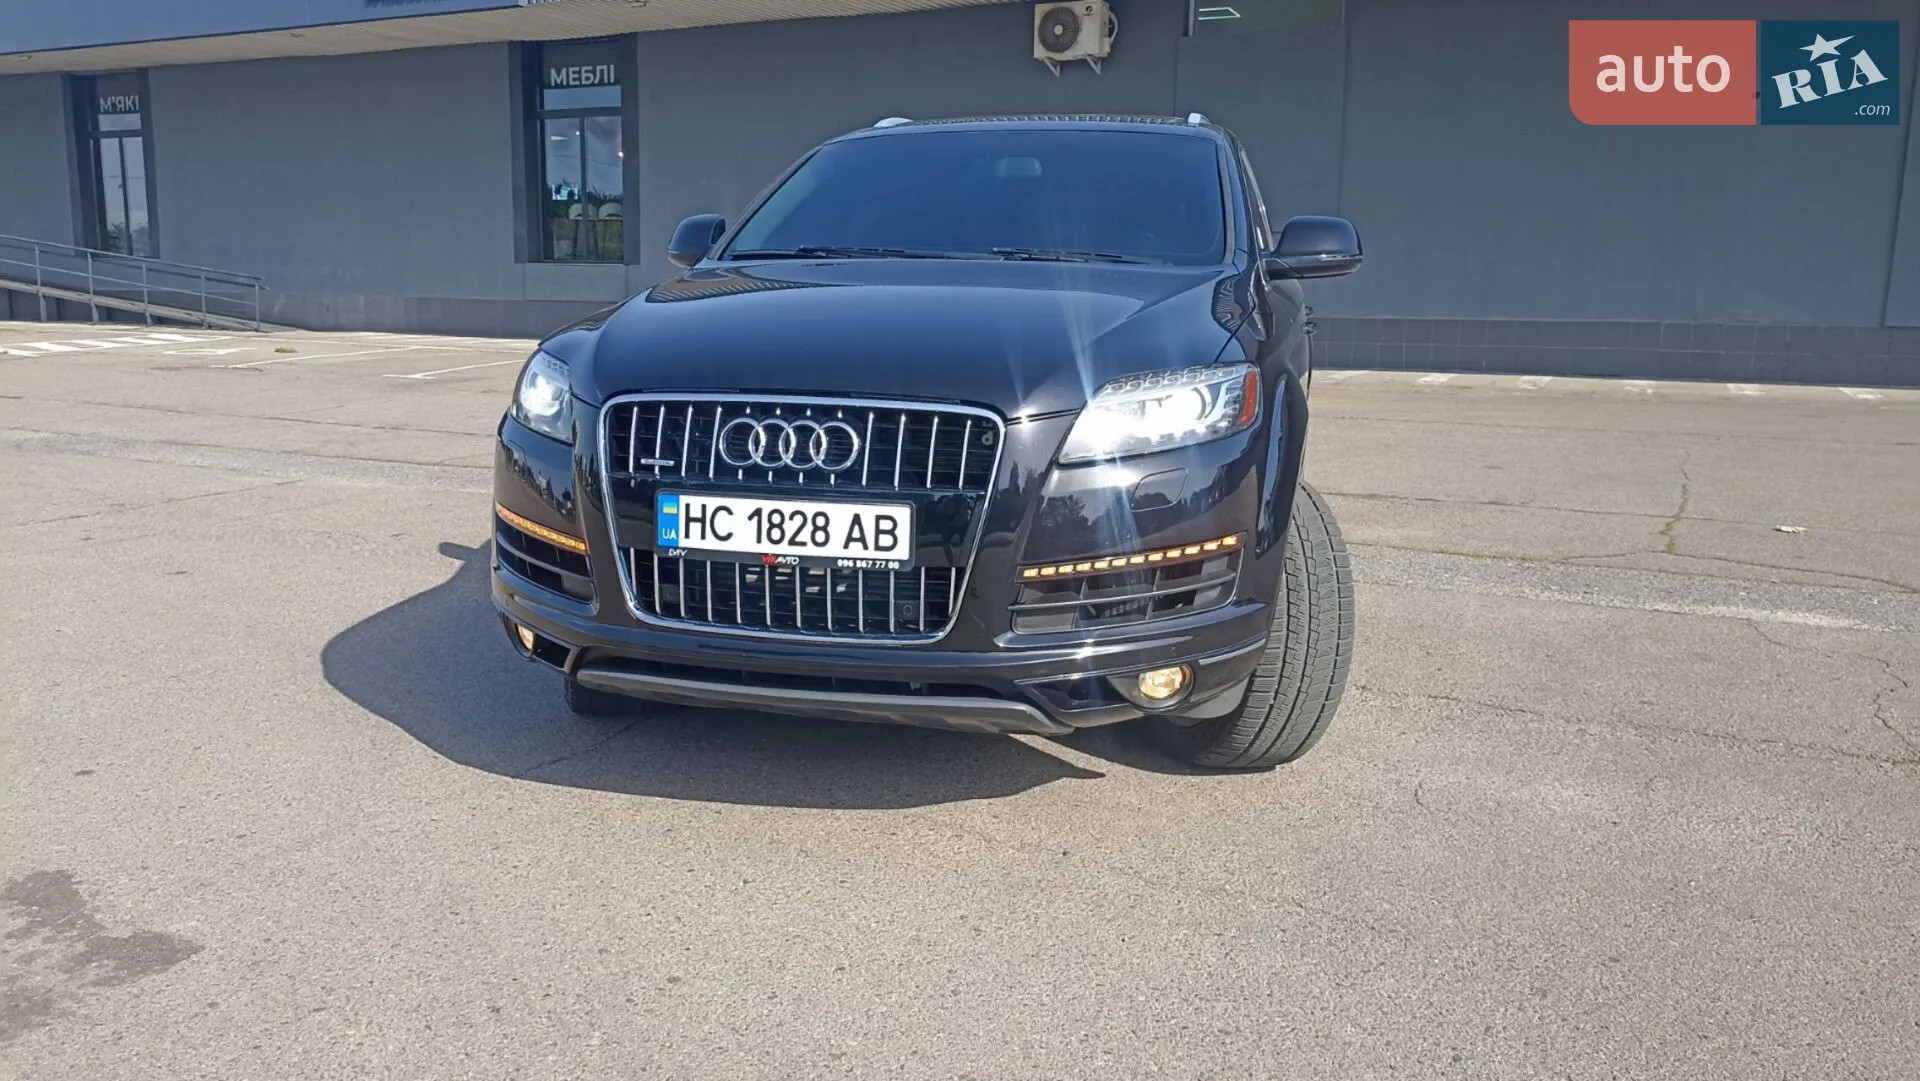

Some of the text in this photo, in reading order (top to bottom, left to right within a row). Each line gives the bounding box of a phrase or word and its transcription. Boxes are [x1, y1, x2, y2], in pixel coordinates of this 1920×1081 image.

[550, 64, 615, 87] МЕБЛІ
[662, 527, 678, 540] UA
[684, 502, 899, 553] HC 1828 AB
[874, 560, 886, 569] 77
